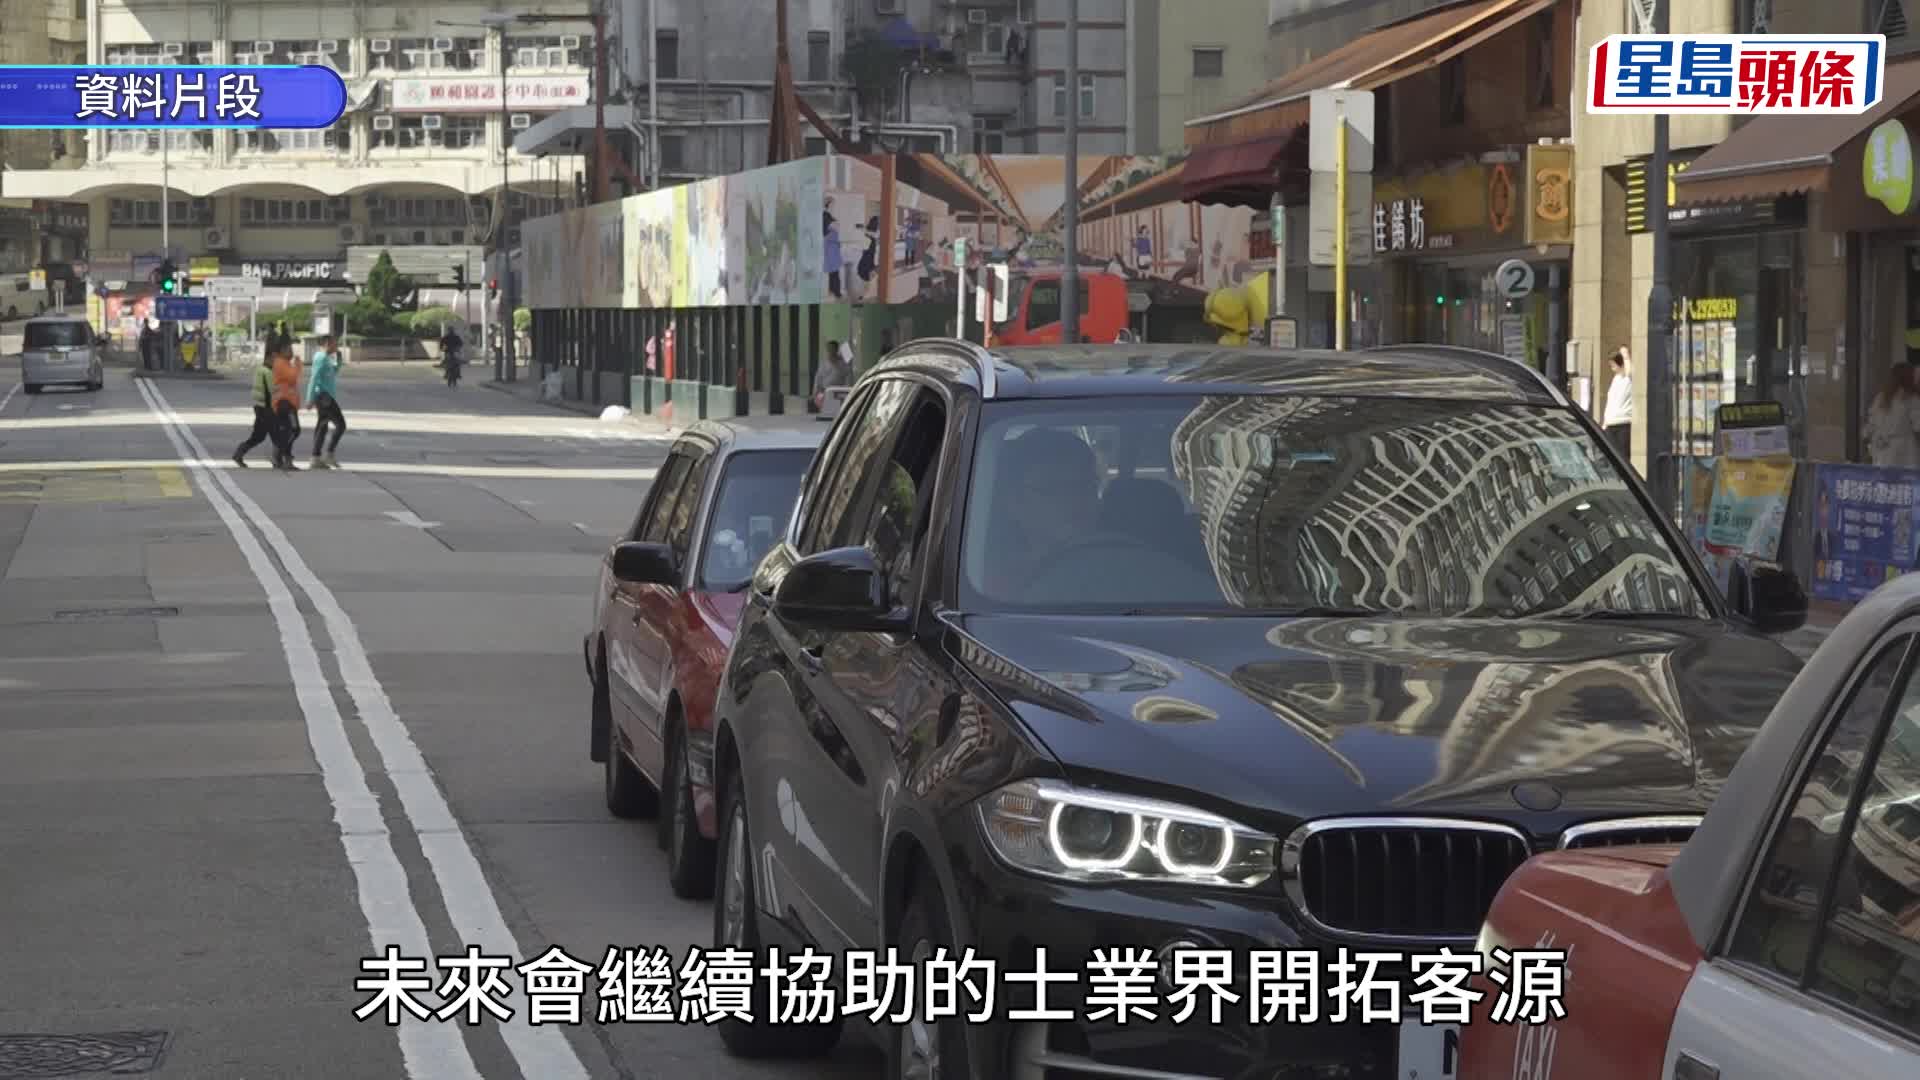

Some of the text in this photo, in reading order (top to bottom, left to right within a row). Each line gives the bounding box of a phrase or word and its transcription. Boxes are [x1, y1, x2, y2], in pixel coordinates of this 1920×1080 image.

[242, 262, 330, 279] BAR PACIFIC
[1507, 267, 1529, 293] 2
